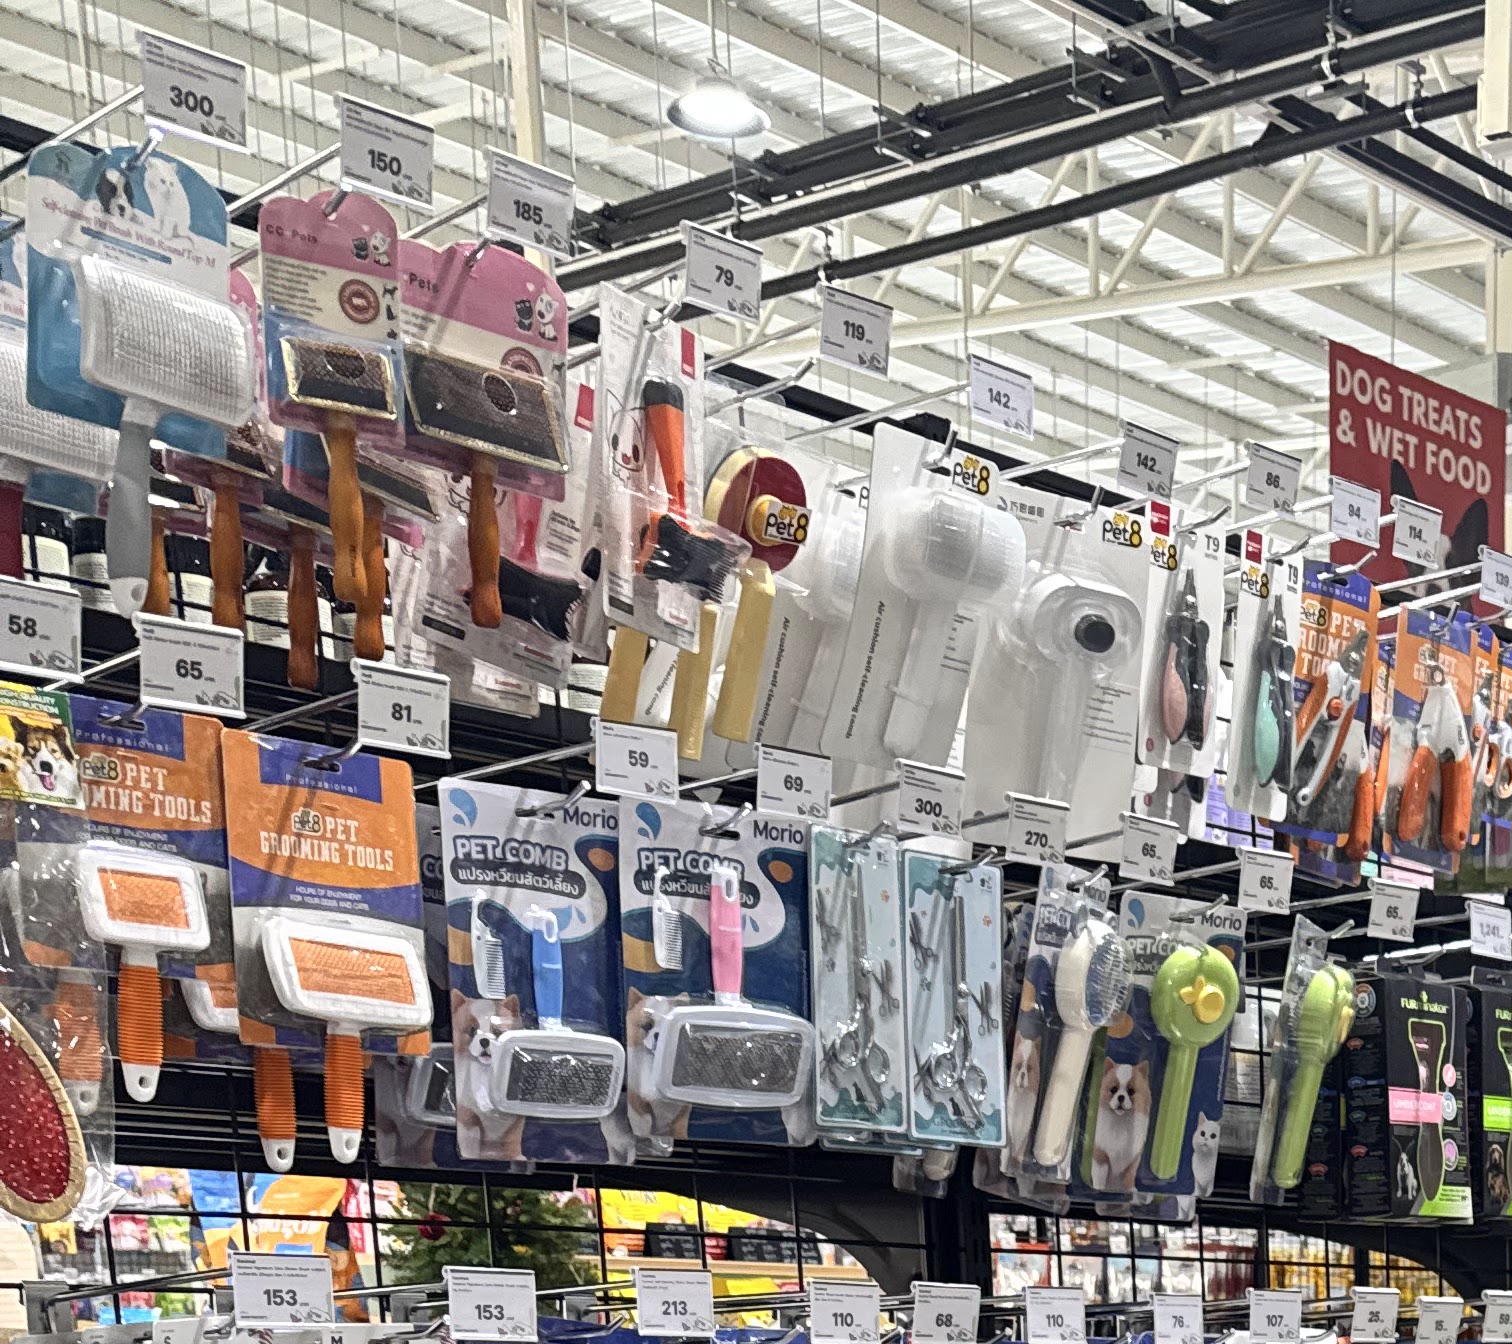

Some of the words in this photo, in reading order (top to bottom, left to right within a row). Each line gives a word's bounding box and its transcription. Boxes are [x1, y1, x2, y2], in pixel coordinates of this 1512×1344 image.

[169, 85, 214, 118] 300
[367, 148, 402, 177] 150
[513, 199, 544, 226] 185
[265, 222, 286, 237] CC
[290, 229, 319, 247] Pets
[408, 271, 441, 295] Pets
[714, 264, 735, 288] 79
[843, 319, 866, 342] 119
[987, 387, 1011, 410] 142
[1336, 359, 1393, 415] DOG
[1398, 385, 1483, 450] TREATS
[1136, 452, 1157, 473] 142
[1336, 408, 1357, 447] &
[1366, 417, 1419, 470] WET
[1425, 441, 1492, 495] FOOD
[1265, 471, 1281, 489] 86
[1347, 503, 1362, 520] 94
[1204, 533, 1220, 553] T9
[1408, 524, 1423, 542] 114
[1287, 563, 1300, 586] T9
[876, 600, 886, 617] Air
[8, 613, 38, 638] 58
[782, 615, 791, 633] Air
[868, 616, 883, 655] cushion
[774, 632, 788, 670] cushion
[175, 658, 203, 681] 65
[851, 655, 874, 714] self-cleaning
[391, 702, 412, 723] 81
[845, 713, 857, 740] comb
[74, 727, 171, 754] Professional
[628, 749, 650, 768] 59
[124, 762, 168, 791] PET
[285, 773, 358, 795] Professional
[783, 774, 804, 793] 69
[150, 793, 213, 825] TOOLS
[563, 805, 620, 832] Morio
[914, 797, 943, 818] 300
[324, 815, 359, 842] PET
[752, 819, 805, 846] Morio
[1024, 830, 1049, 849] 270
[259, 831, 342, 865] GROOMING
[343, 844, 395, 872] TOOLS
[454, 837, 499, 861] PET
[503, 839, 568, 872] COMB
[639, 850, 682, 873] PET
[1141, 842, 1157, 859] 65
[1259, 875, 1274, 891] 65
[1201, 911, 1242, 931] Morio
[1385, 905, 1403, 921] 65
[1128, 936, 1156, 956] PET
[262, 1288, 298, 1307] 153
[661, 1300, 688, 1316] 213
[474, 1304, 505, 1321] 153
[831, 1312, 854, 1328] 110
[935, 1313, 953, 1328] 68
[1045, 1313, 1064, 1328] 110
[1171, 1315, 1185, 1329] 76
[1265, 1314, 1284, 1328] 107
[1367, 1310, 1385, 1324] 25
